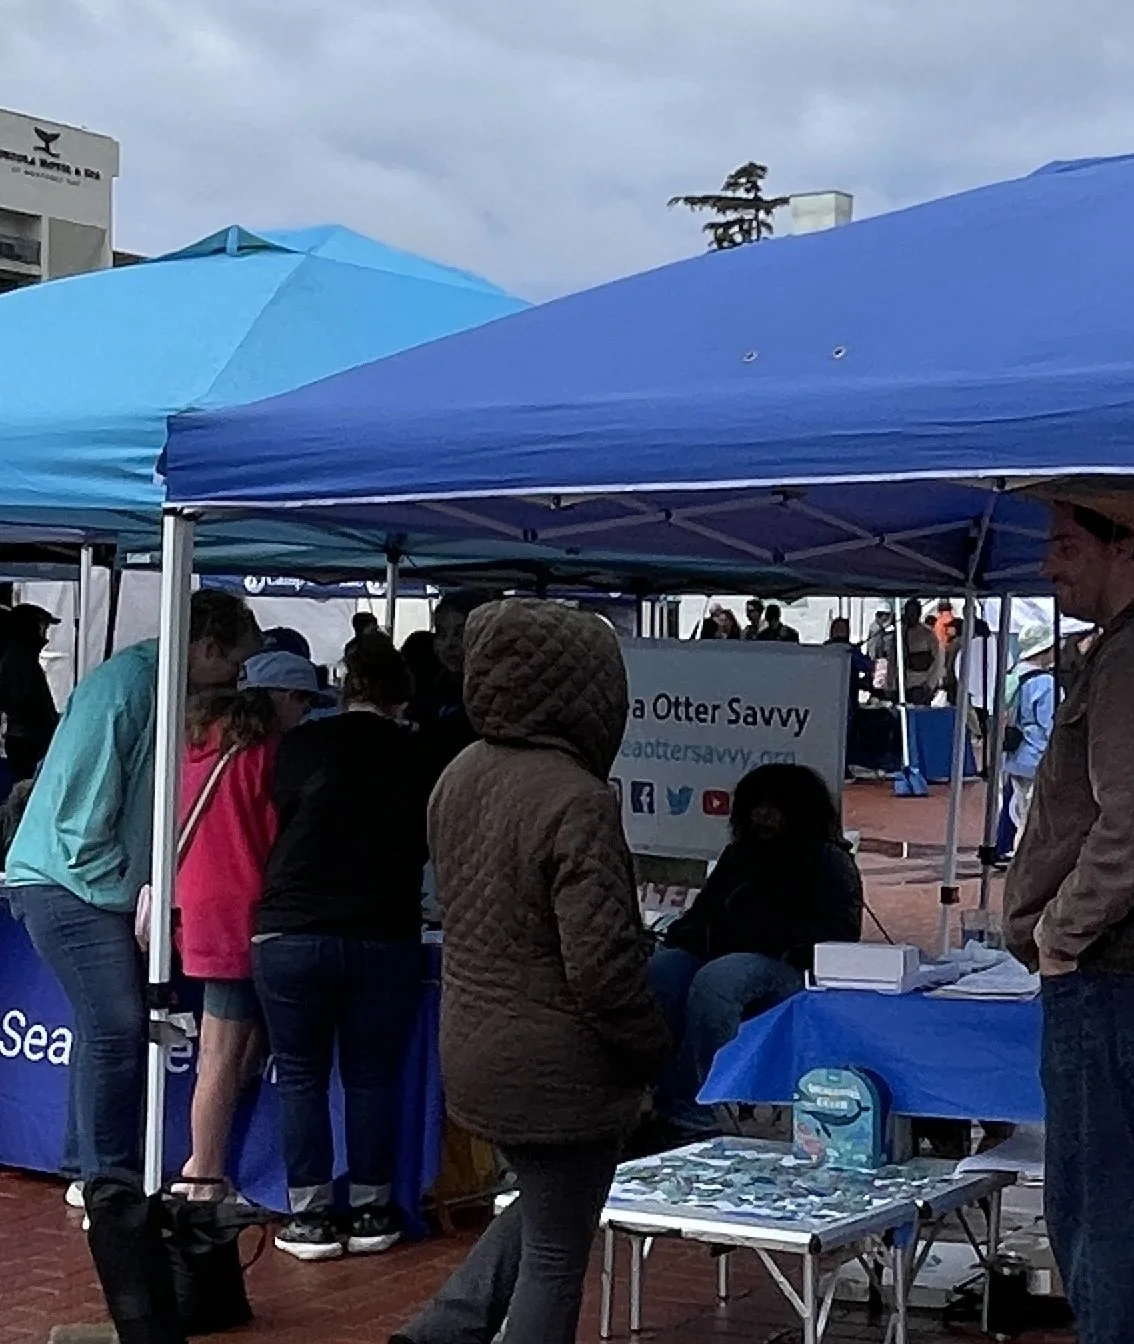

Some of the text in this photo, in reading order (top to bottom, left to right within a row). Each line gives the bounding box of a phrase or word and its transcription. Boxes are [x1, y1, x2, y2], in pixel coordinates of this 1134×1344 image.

[652, 692, 722, 725] Otter
[726, 696, 811, 739] Savvy
[0, 1010, 74, 1067] Sea
